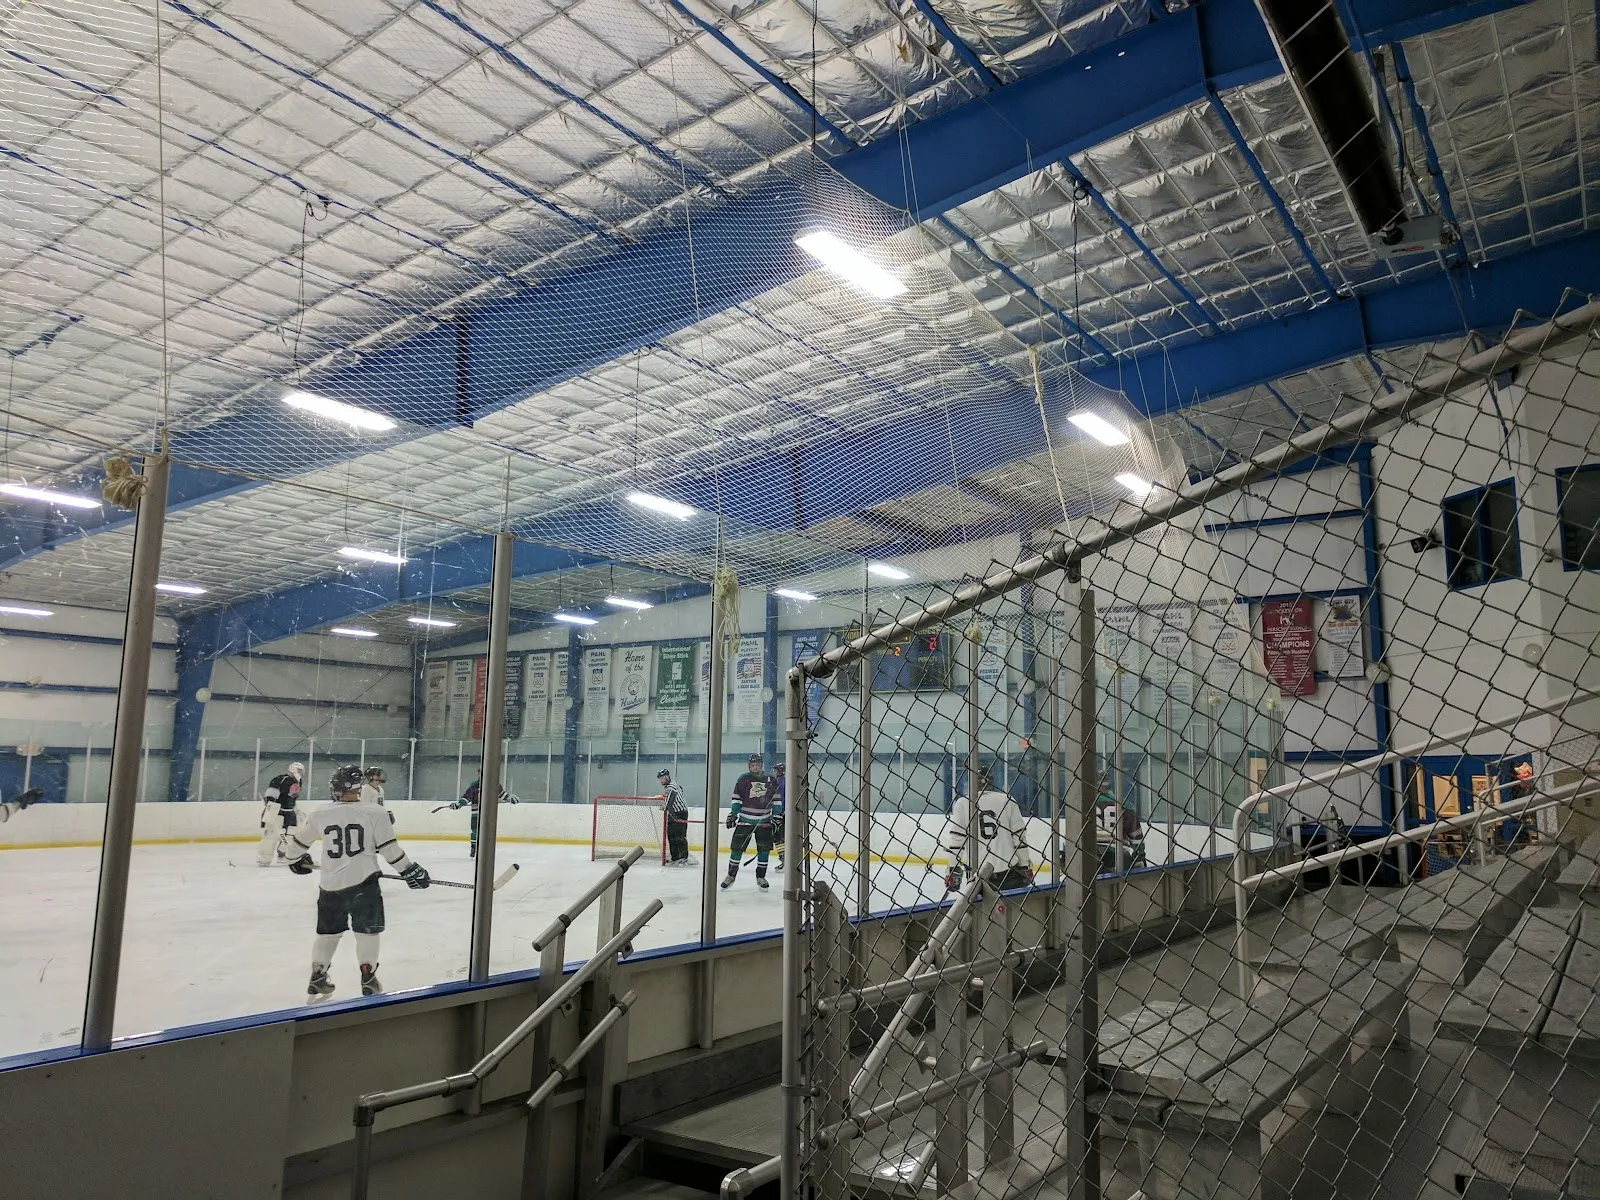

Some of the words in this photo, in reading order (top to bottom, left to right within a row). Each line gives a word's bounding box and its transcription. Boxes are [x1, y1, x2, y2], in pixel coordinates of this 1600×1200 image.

[624, 650, 646, 663] Home
[625, 663, 633, 674] of
[633, 662, 644, 672] the
[979, 809, 998, 840] 6
[323, 823, 366, 859] 30
